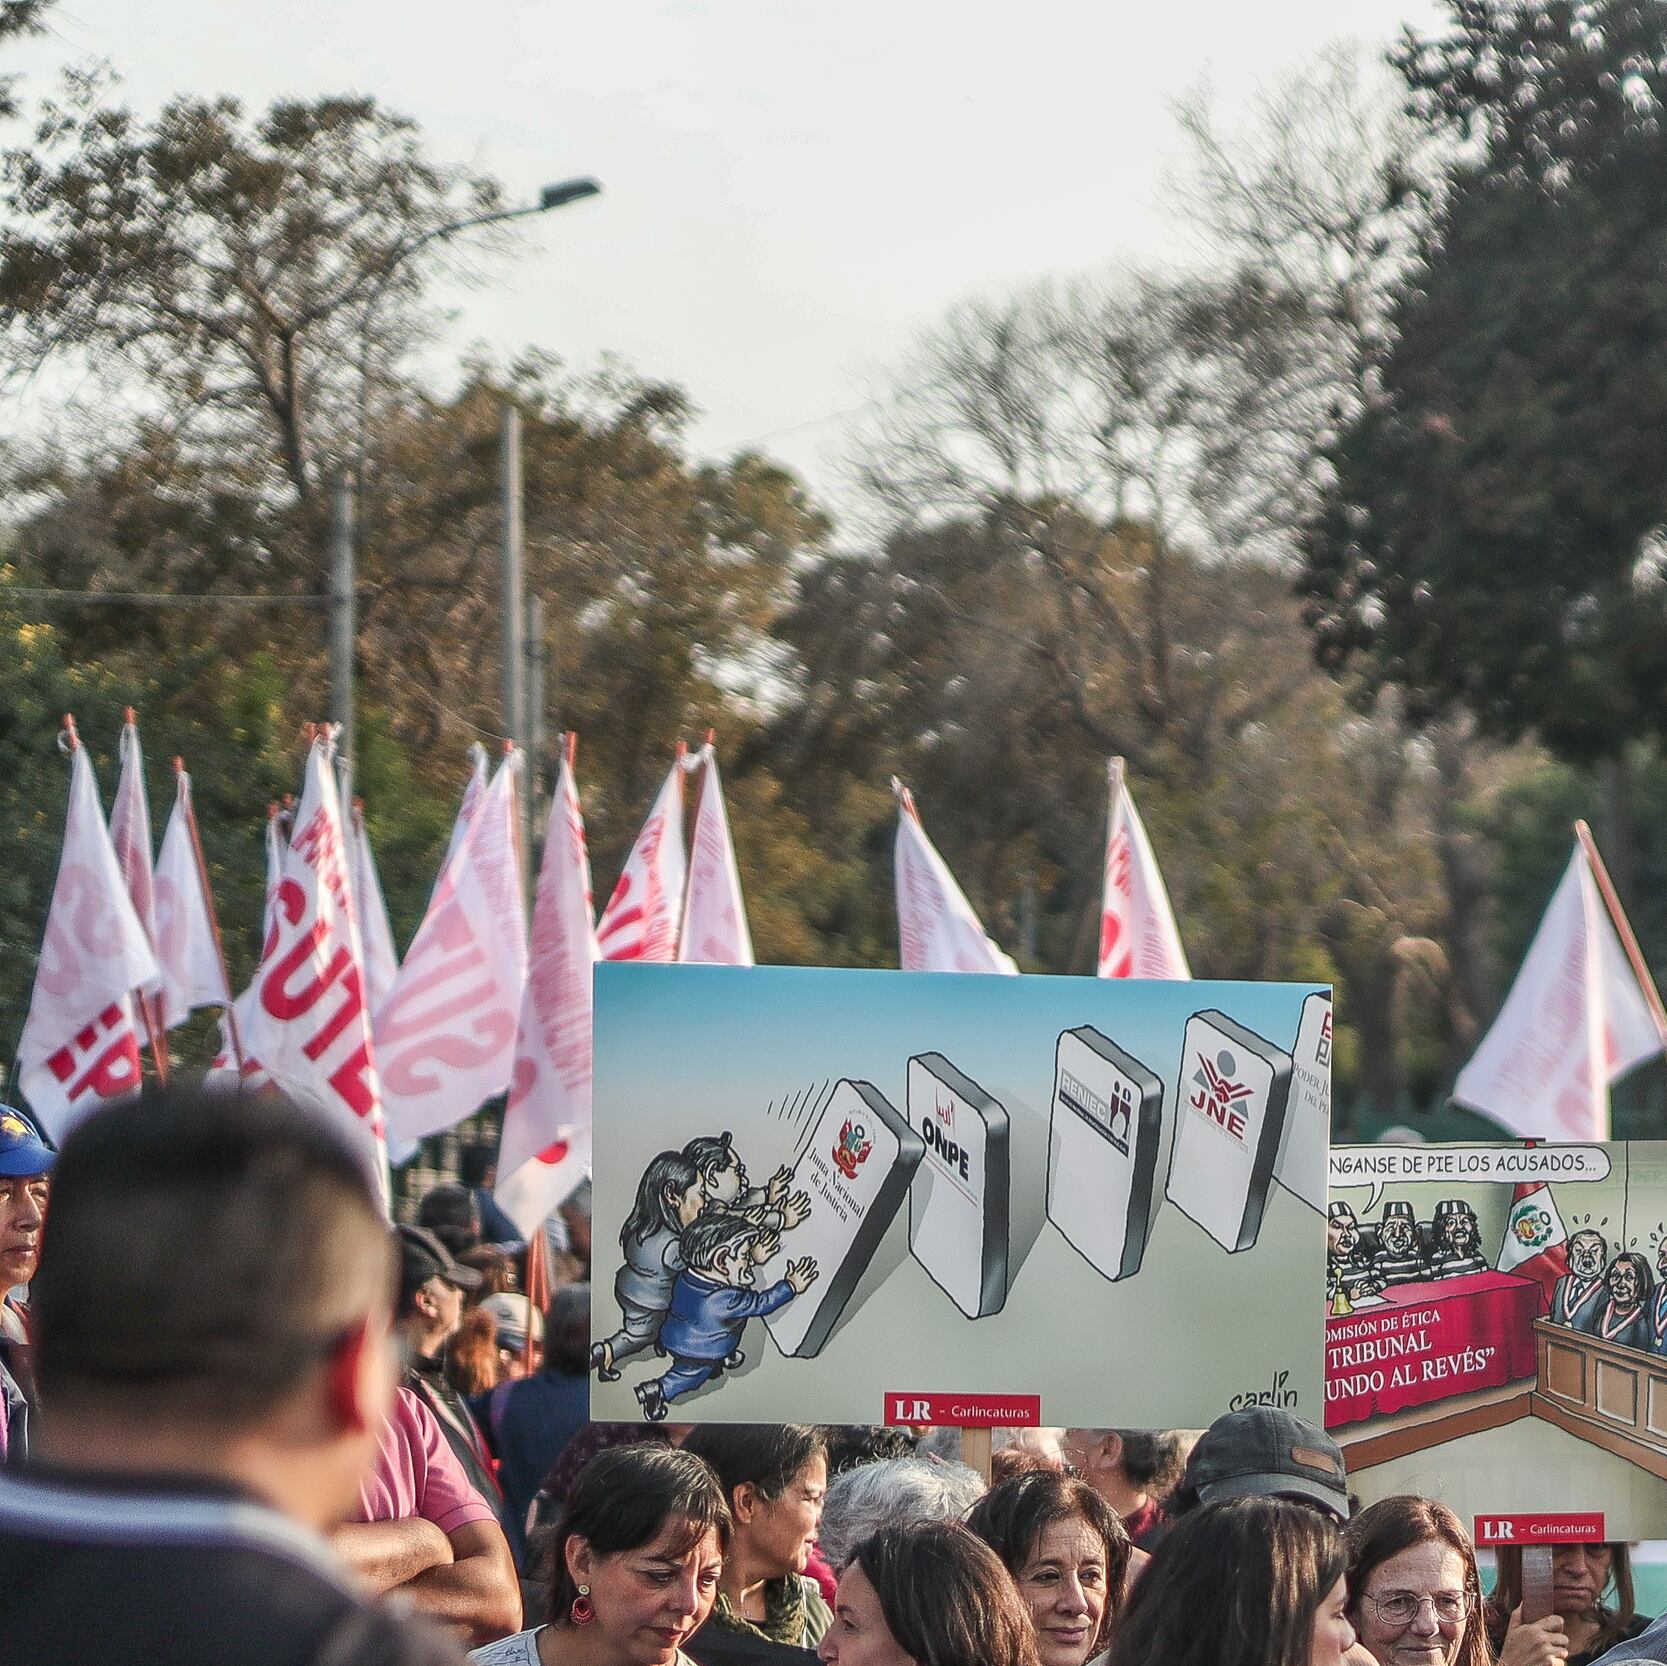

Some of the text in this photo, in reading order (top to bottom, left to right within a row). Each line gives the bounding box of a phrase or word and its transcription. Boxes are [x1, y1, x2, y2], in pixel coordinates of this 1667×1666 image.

[1292, 1062, 1320, 1089] PODER
[1061, 1074, 1106, 1121] RENIEC
[1190, 1089, 1246, 1140] JNE
[1305, 1092, 1318, 1109] DEL
[922, 1117, 969, 1181] ONPE
[1329, 1154, 1597, 1174] NGANSE DE PIE LOS ACUSADOS...
[807, 1147, 830, 1177] Junta
[830, 1171, 866, 1219] Nacional
[810, 1172, 848, 1224] de Justicia
[1380, 1317, 1399, 1332] DE
[1402, 1308, 1441, 1329] ÉTICA
[1328, 1329, 1433, 1370] TRIBUNAL
[1325, 1370, 1385, 1402] UNDO
[1389, 1364, 1418, 1390] AL
[894, 1399, 933, 1421] LR
[951, 1404, 1031, 1420] Carlincaturas
[1483, 1520, 1515, 1539] LR
[1529, 1523, 1597, 1535] Carlincaturas
